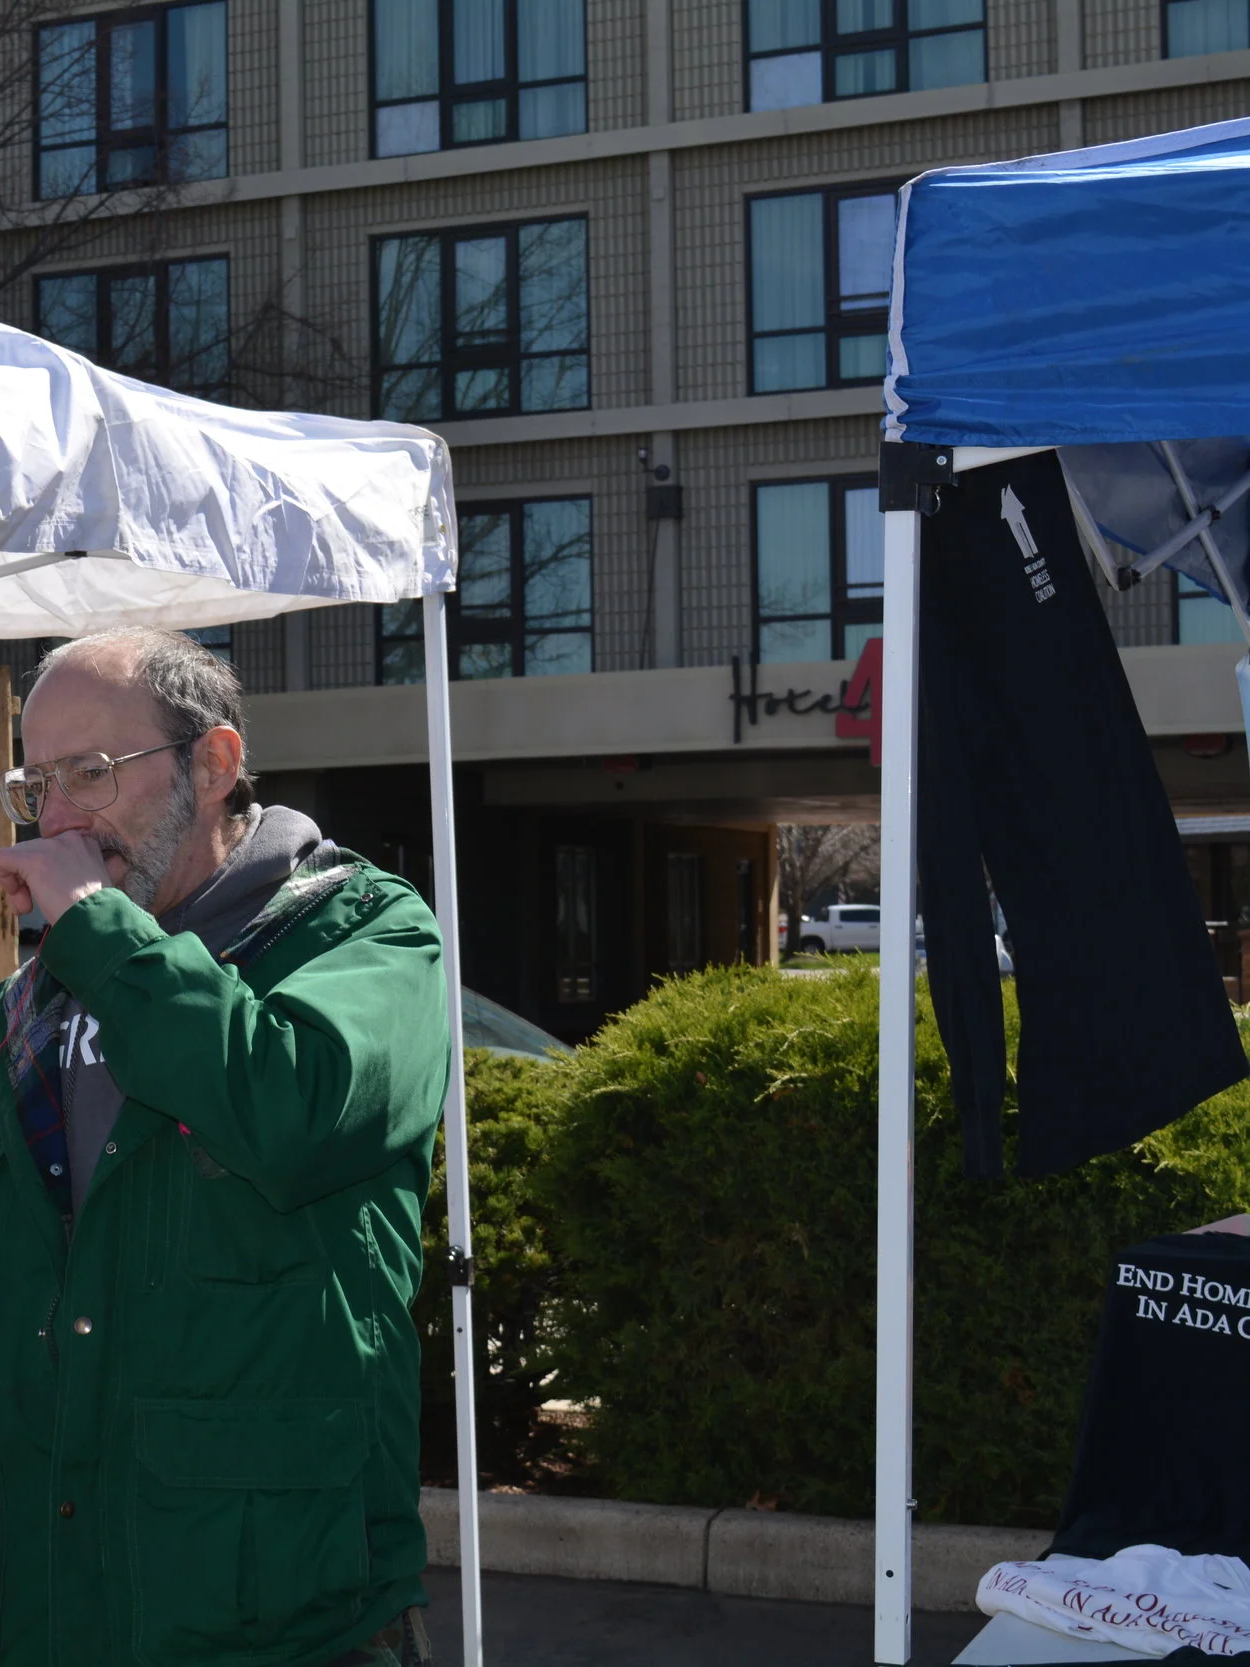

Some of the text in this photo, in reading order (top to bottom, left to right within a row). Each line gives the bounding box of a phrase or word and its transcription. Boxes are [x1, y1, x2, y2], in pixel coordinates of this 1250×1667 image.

[728, 655, 872, 744] Hotel
[1116, 1263, 1174, 1292] END
[1136, 1295, 1168, 1321] IN
[1172, 1303, 1232, 1334] ADA
